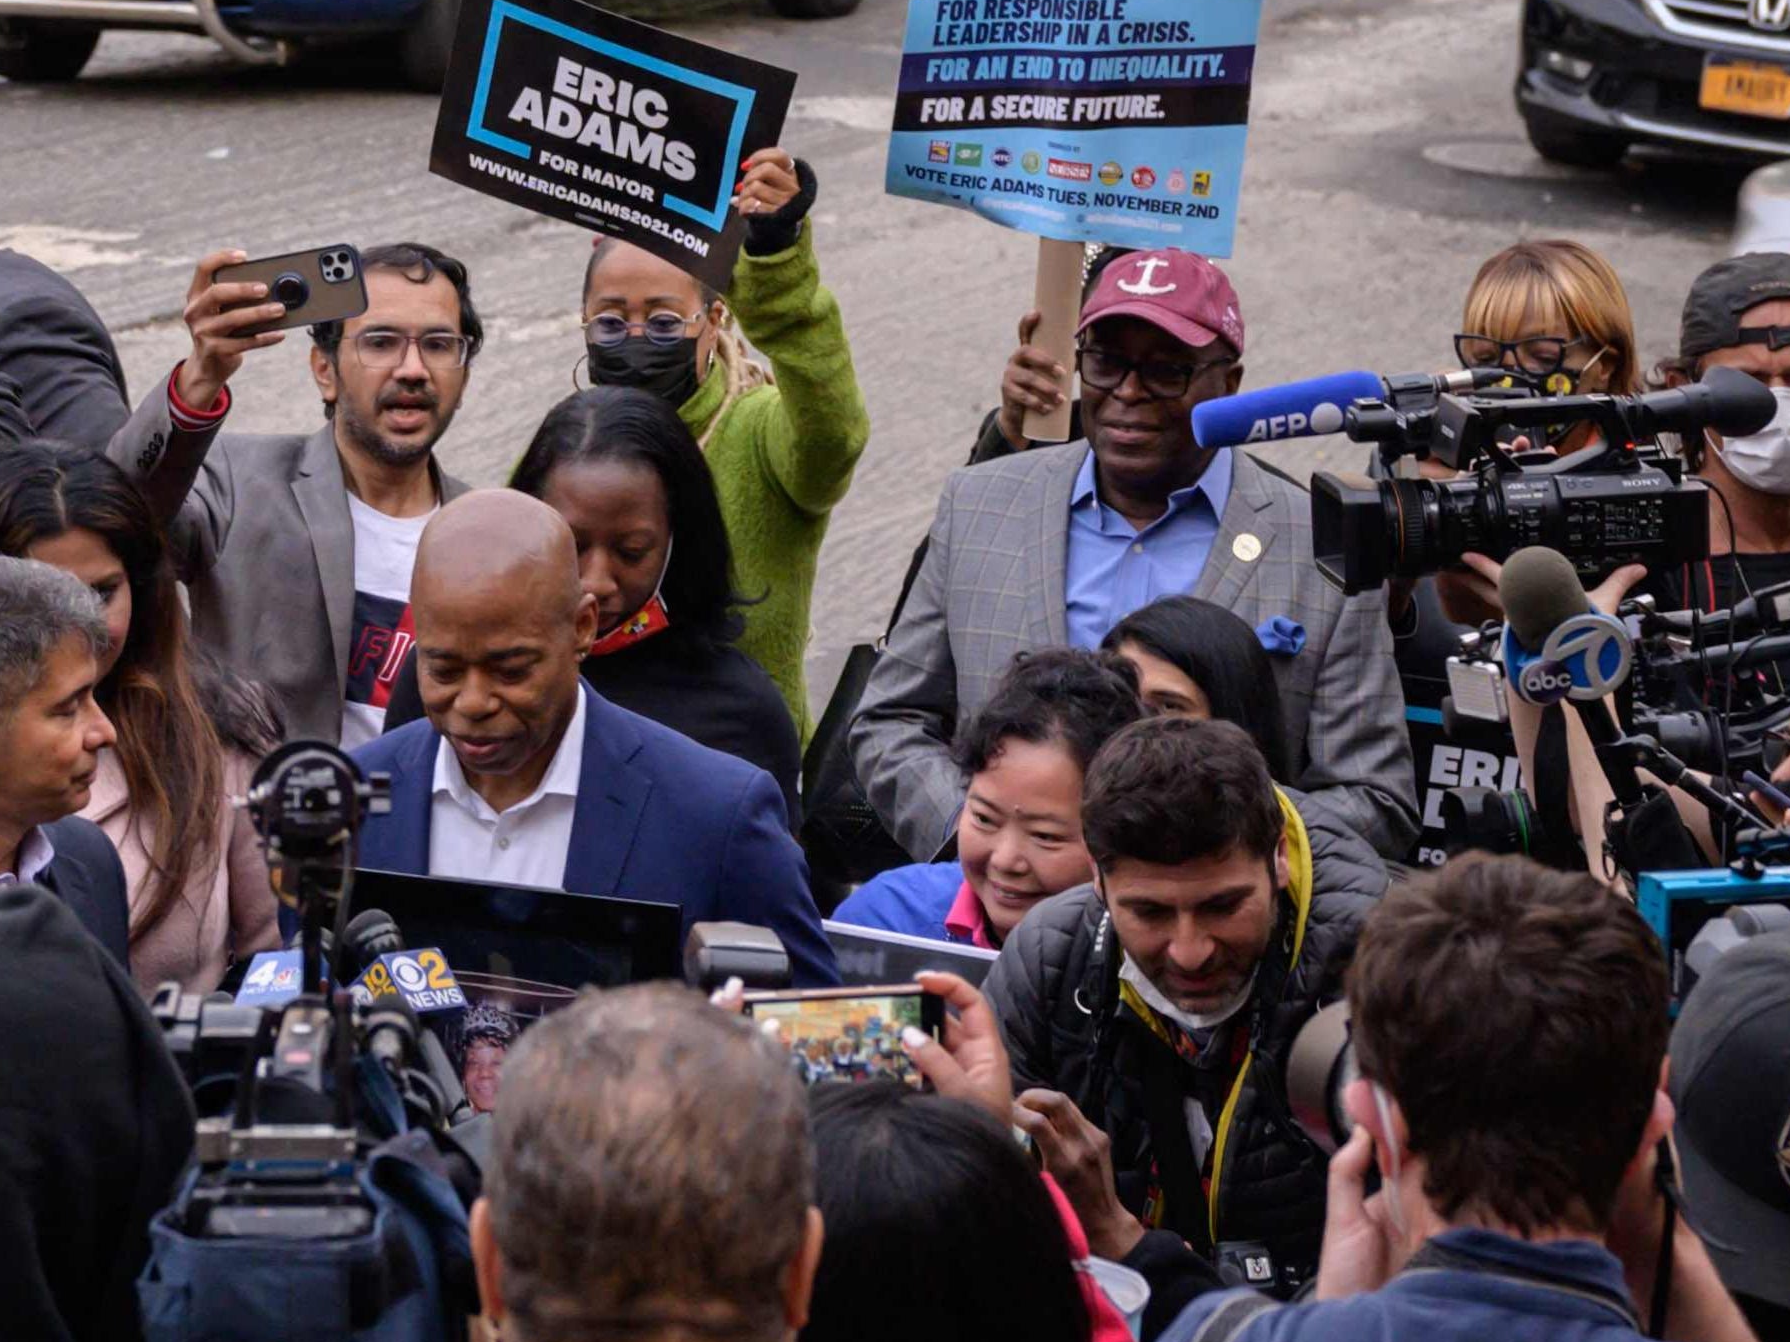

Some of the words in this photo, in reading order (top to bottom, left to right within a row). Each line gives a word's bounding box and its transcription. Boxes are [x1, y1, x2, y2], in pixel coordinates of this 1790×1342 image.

[936, 0, 978, 23] FOR
[932, 20, 1062, 47] LEADERSHIP
[1066, 23, 1089, 45] IN
[1095, 24, 1112, 45] A
[1116, 20, 1197, 45] CRISIS.
[925, 57, 970, 83] FOR
[972, 55, 1009, 80] AN
[1010, 55, 1054, 80] END
[1058, 56, 1086, 81] TO
[1088, 52, 1227, 82] INEQUALITY.
[552, 55, 669, 129] ERIC
[919, 95, 966, 124] FOR
[967, 95, 987, 121] A
[989, 94, 1070, 121] SECURE
[1071, 93, 1167, 121] FUTURE.
[508, 85, 697, 182] ADAMS
[539, 150, 579, 177] FOR
[581, 160, 655, 203] MAYOR
[904, 163, 948, 185] VOTE
[949, 171, 988, 191] ERIC
[990, 177, 1046, 199] ADAMS
[1047, 186, 1091, 208] TUES,
[1093, 192, 1185, 217] NOVEMBER
[1186, 201, 1220, 220] 2ND
[468, 152, 710, 258] WWW.ERICADAMS2021.COM
[1243, 412, 1308, 443] AFP
[1621, 479, 1662, 488] SONY
[1525, 670, 1572, 692] abc
[1428, 743, 1522, 796] ERI
[418, 950, 456, 990] 2
[406, 990, 462, 1009] NEWS
